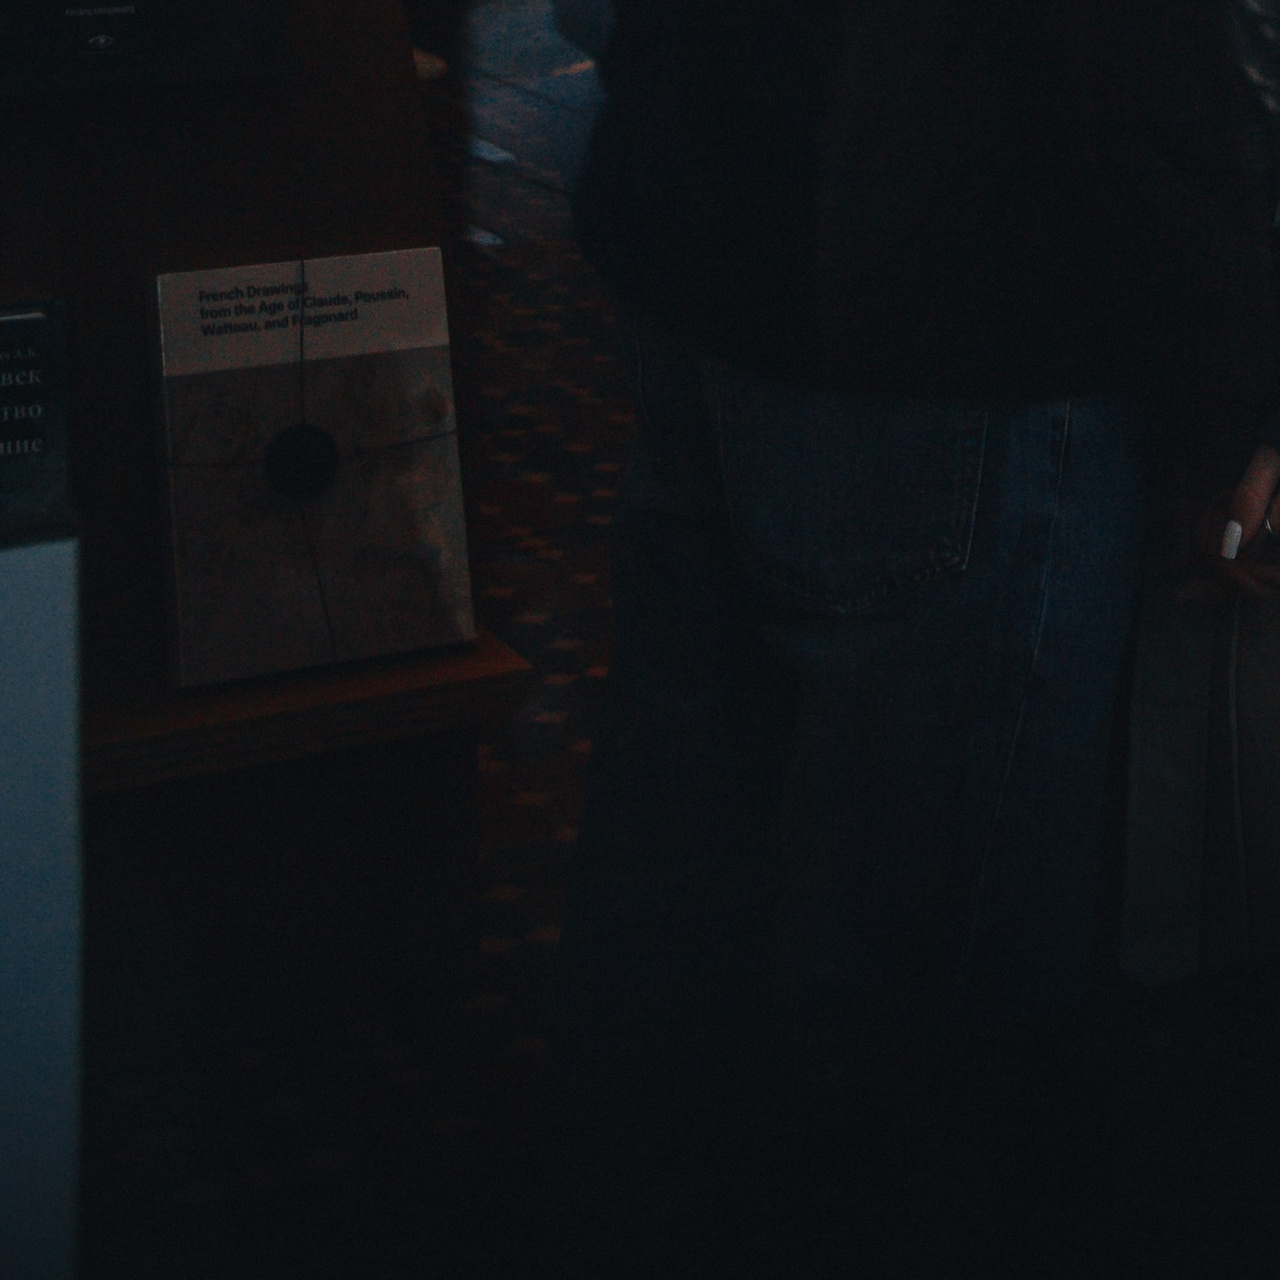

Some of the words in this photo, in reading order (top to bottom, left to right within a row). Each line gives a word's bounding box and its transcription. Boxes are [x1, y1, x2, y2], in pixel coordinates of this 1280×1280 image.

[199, 287, 244, 302] French
[200, 305, 232, 320] from
[234, 302, 256, 316] the
[258, 301, 284, 316] Age
[264, 316, 289, 331] and
